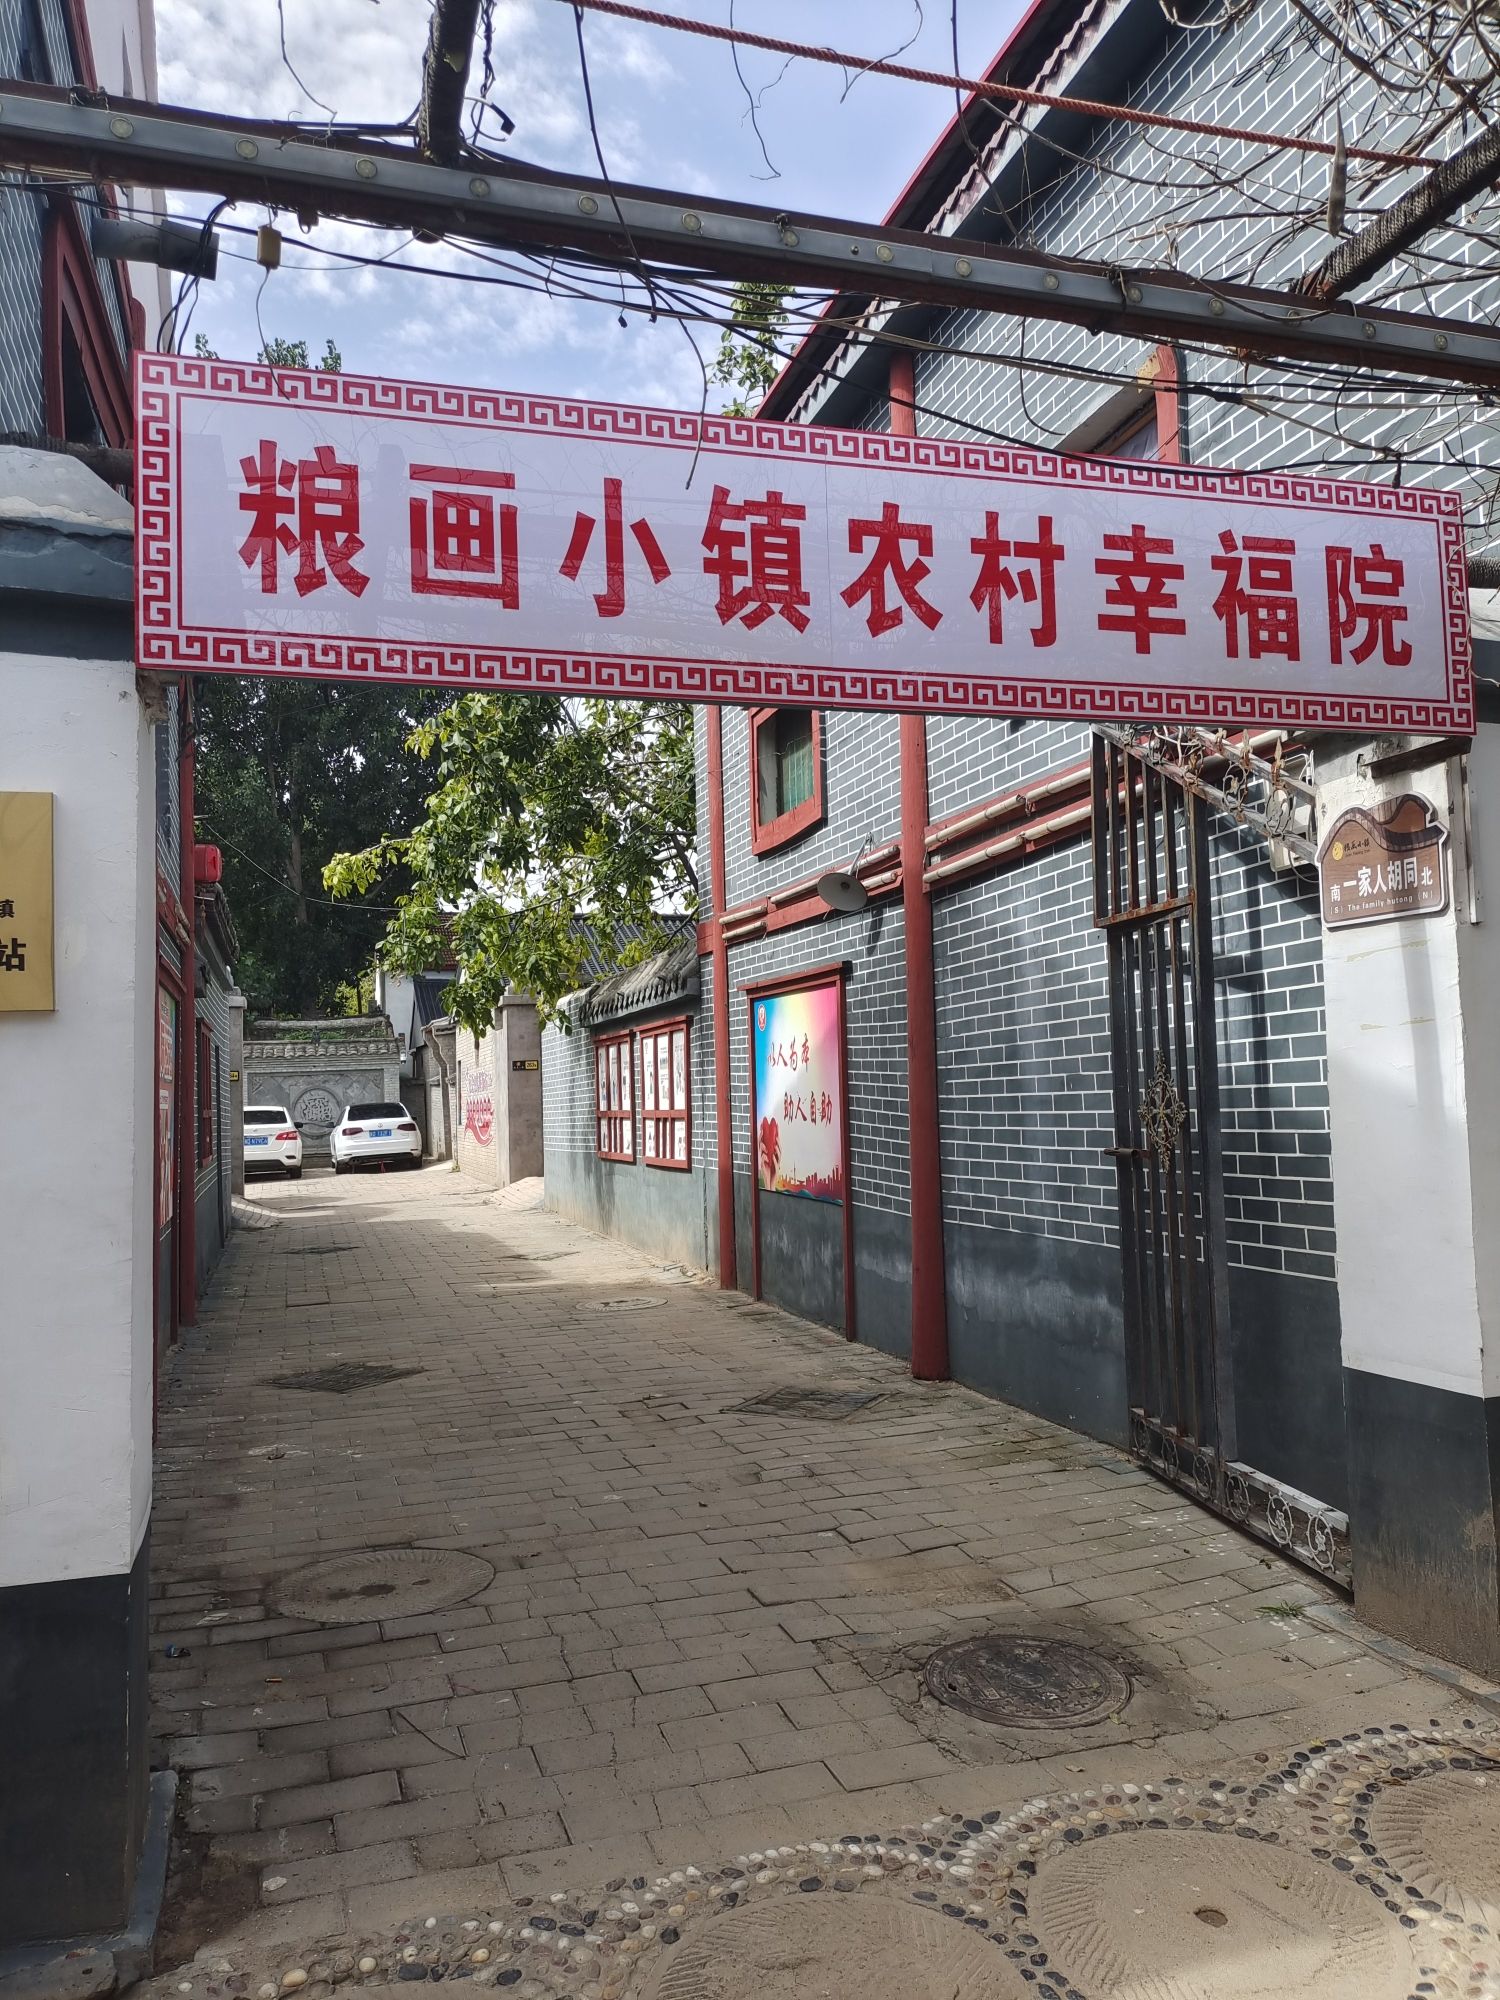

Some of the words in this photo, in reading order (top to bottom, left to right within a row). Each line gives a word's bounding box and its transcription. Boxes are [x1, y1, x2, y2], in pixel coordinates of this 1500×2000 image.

[239, 439, 1412, 666] 粮画小镇农村幸福院
[1330, 884, 1341, 902] 南
[1343, 856, 1418, 898] 一家人胡同
[1421, 866, 1433, 886] 北
[1362, 899, 1384, 909] family
[1387, 895, 1413, 905] hutong
[0, 938, 26, 971] 站
[783, 1091, 832, 1126] 助人自助
